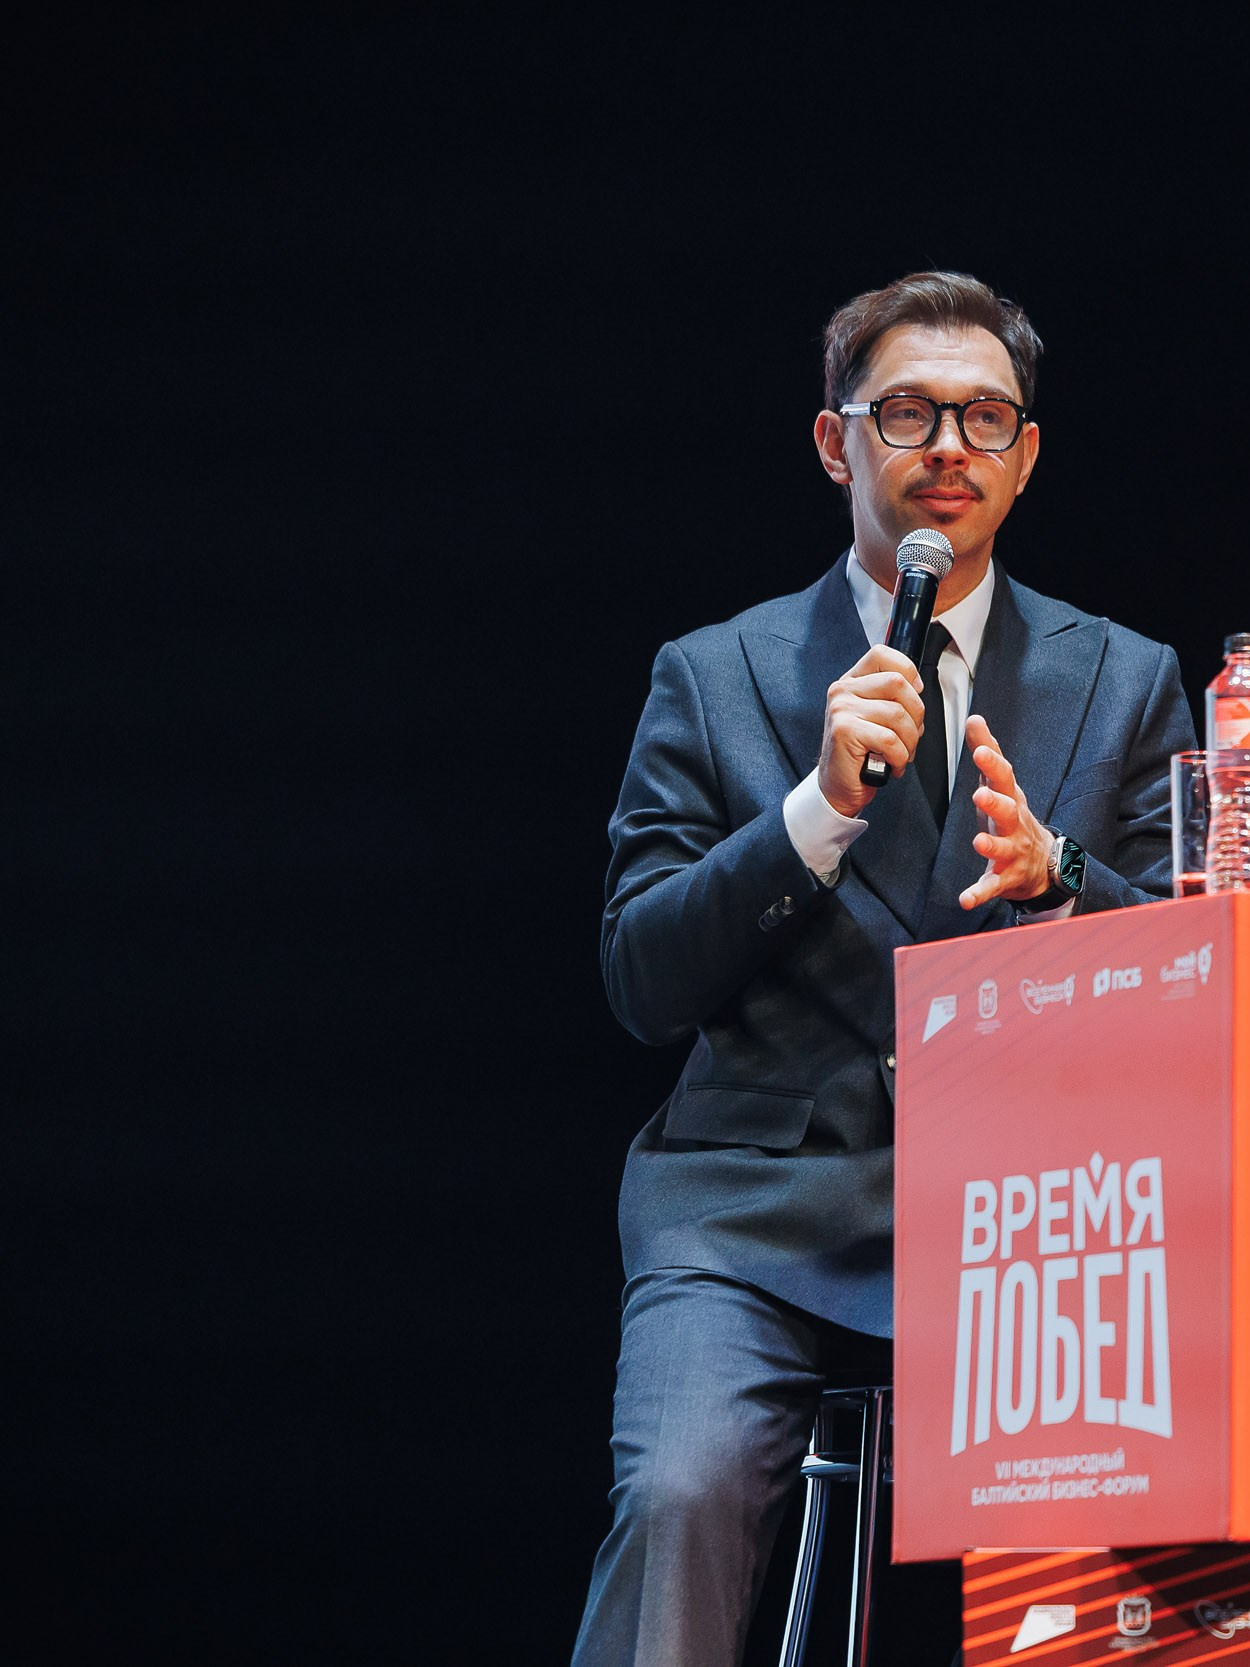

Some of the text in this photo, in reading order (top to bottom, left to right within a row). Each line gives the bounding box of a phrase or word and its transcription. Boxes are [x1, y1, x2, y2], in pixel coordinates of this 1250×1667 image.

[1112, 966, 1142, 991] ПСБ
[961, 1151, 1164, 1264] ВРЕМЯ
[950, 1246, 1172, 1457] ПОБЕД
[1013, 1447, 1125, 1478] МЕЖДУНАРОДНЫЙ
[971, 1474, 1149, 1506] БАЛТИЙСКИЙ БИЗНЕС-ФОРУМ
